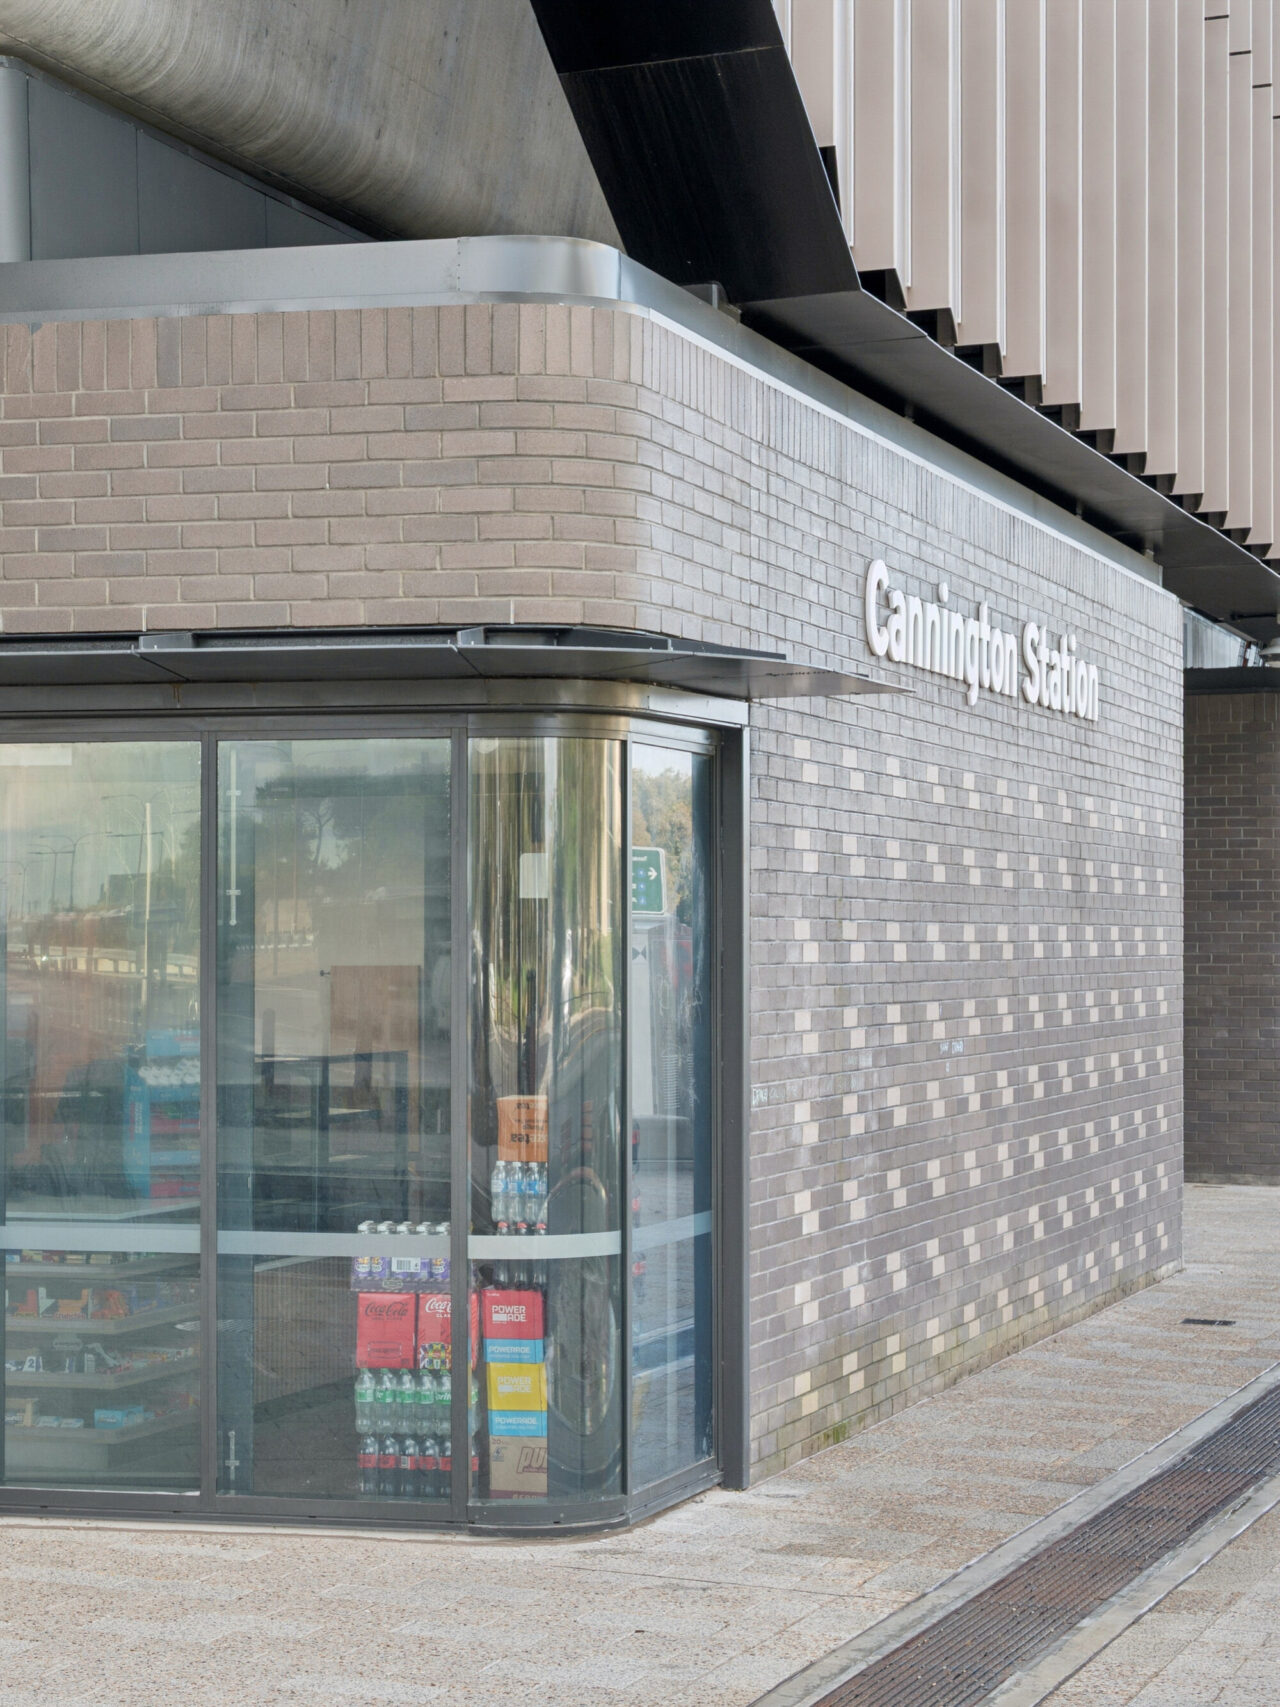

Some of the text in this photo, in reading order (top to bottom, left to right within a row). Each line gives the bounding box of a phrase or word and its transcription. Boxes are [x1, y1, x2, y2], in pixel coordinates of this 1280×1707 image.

[866, 559, 1098, 721] Cannington Station
[492, 1306, 526, 1314] POWER
[508, 1314, 526, 1322] ADE
